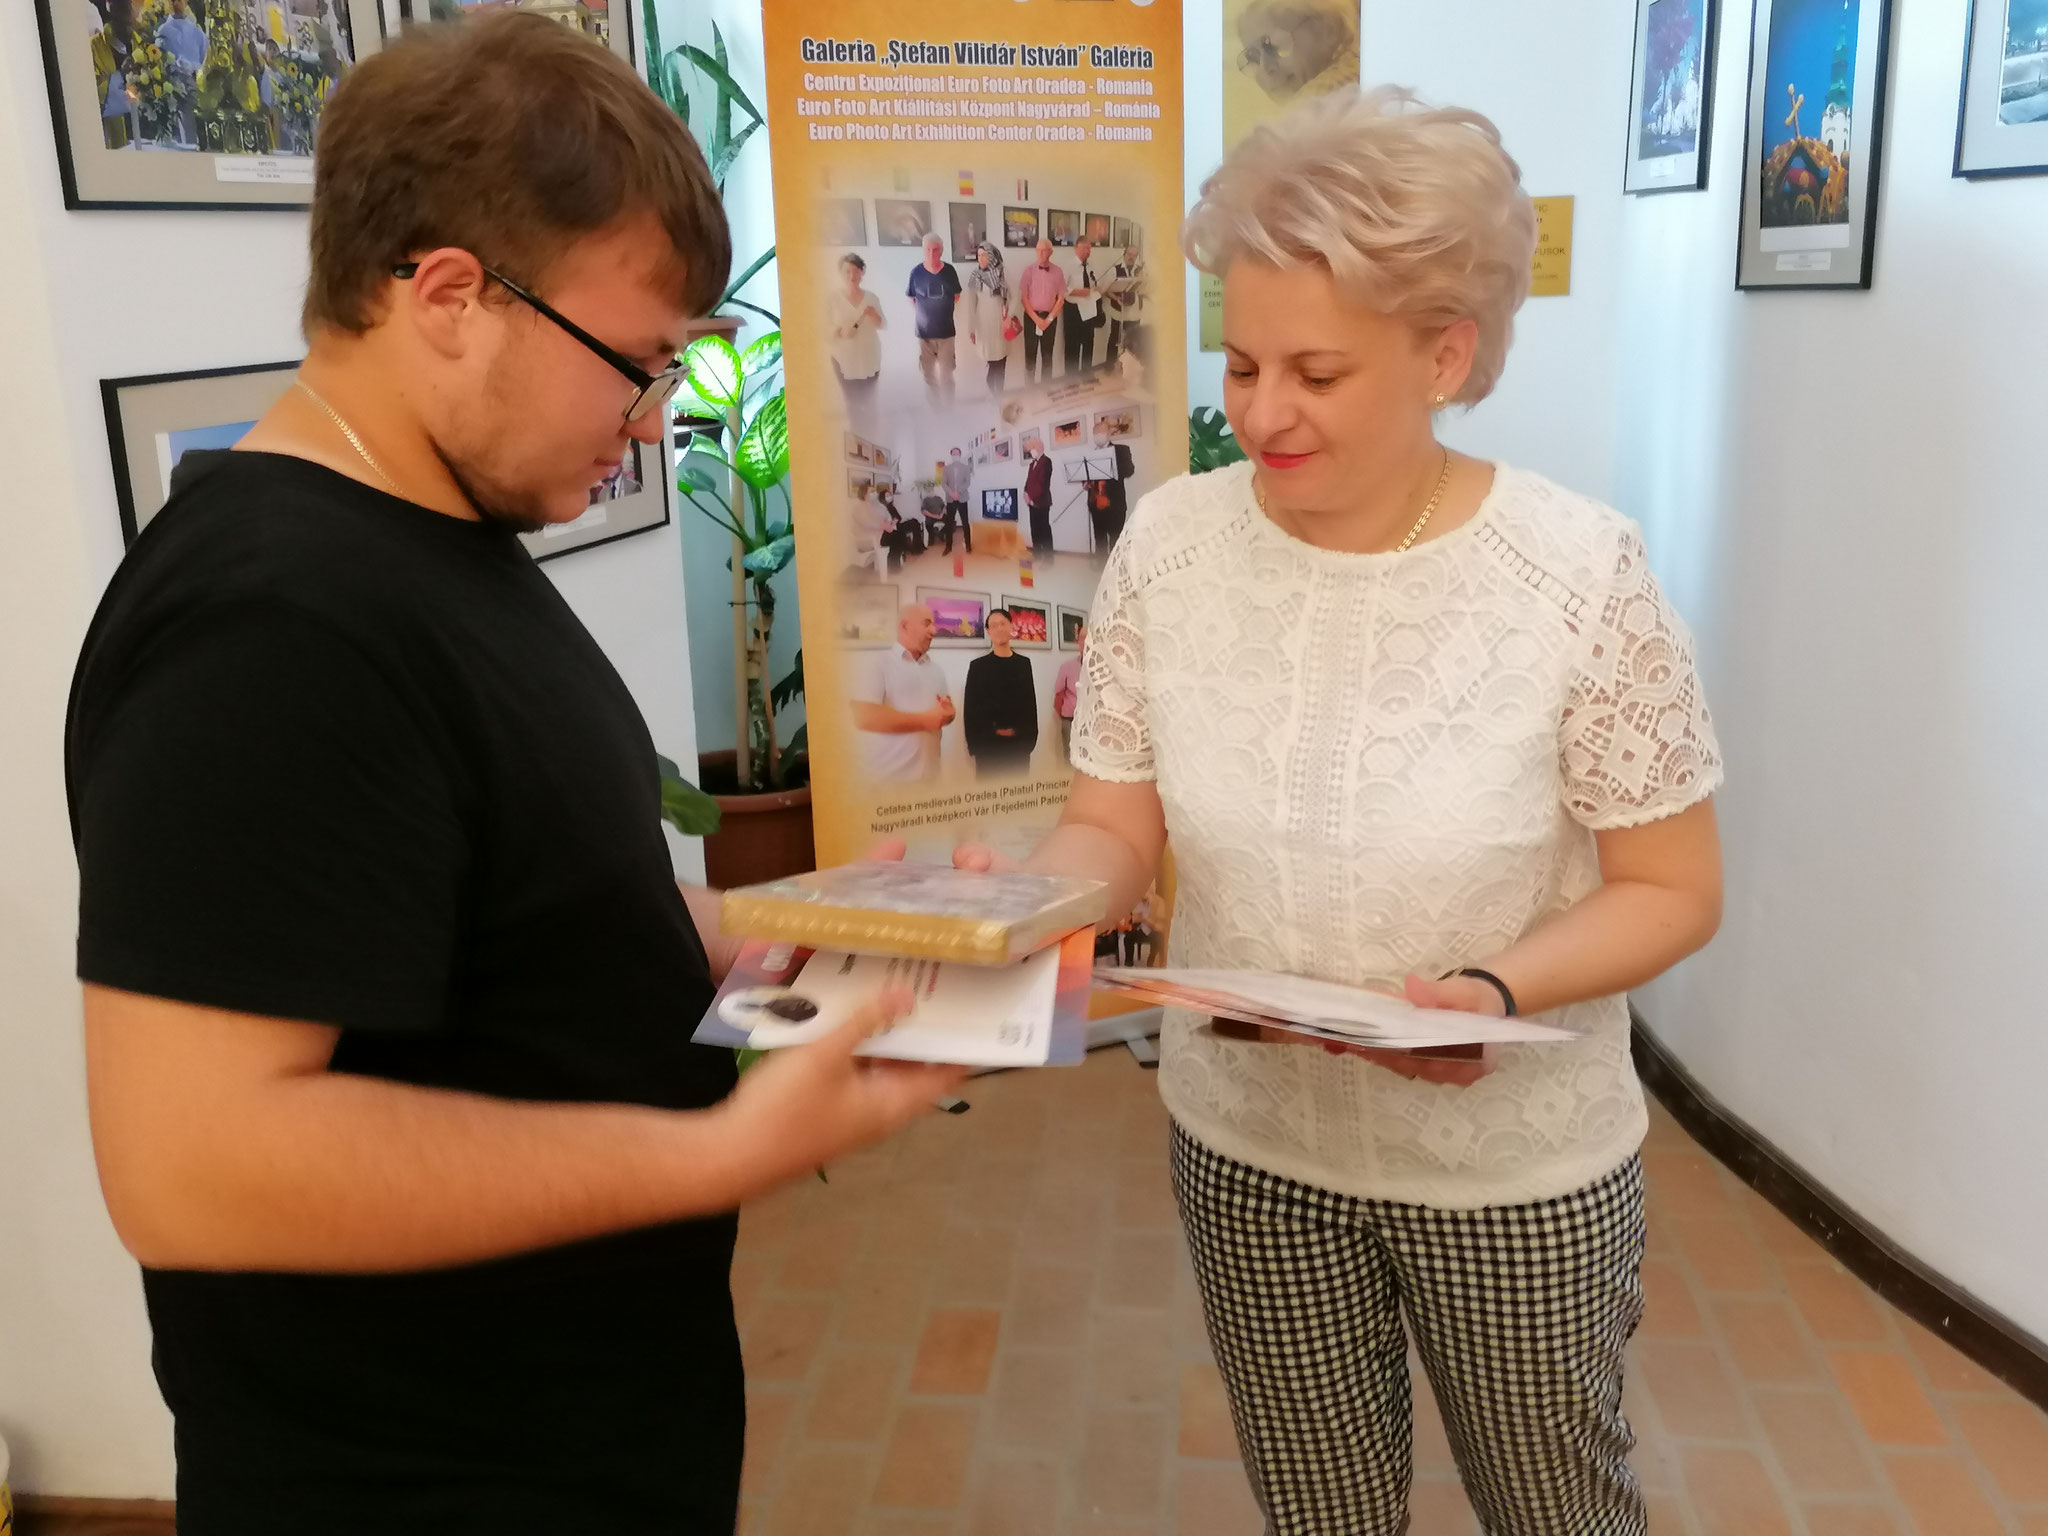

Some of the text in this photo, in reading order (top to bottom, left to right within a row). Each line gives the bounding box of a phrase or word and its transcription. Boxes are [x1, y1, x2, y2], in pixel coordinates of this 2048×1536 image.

[801, 37, 876, 63] Galeria
[953, 42, 1016, 66] Vilidár
[1020, 44, 1086, 67] István”
[1090, 45, 1154, 69] Galéria
[804, 73, 856, 91] Centru
[948, 76, 979, 93] Euro
[982, 76, 1011, 93] Foto
[1013, 77, 1033, 94] Art
[1036, 77, 1086, 94] Oradea
[1096, 77, 1154, 95] Romania
[797, 98, 832, 116] Euro
[834, 98, 867, 116] Foto
[869, 99, 892, 116] Art
[960, 99, 1015, 118] Központ
[1017, 100, 1091, 119] Nagyvárad
[809, 122, 844, 140] Euro
[846, 123, 889, 140] Photo
[891, 123, 913, 140] Art
[915, 123, 985, 141] Exhibition
[987, 124, 1033, 141] Center
[1035, 124, 1085, 141] Oradea
[1095, 124, 1153, 141] Romania
[876, 803, 912, 817] Cetatea
[964, 790, 998, 804] Oradea
[999, 783, 1034, 799] (Palatul
[870, 815, 924, 833] Nagyváradi
[992, 799, 1039, 815] (Fejedelmi
